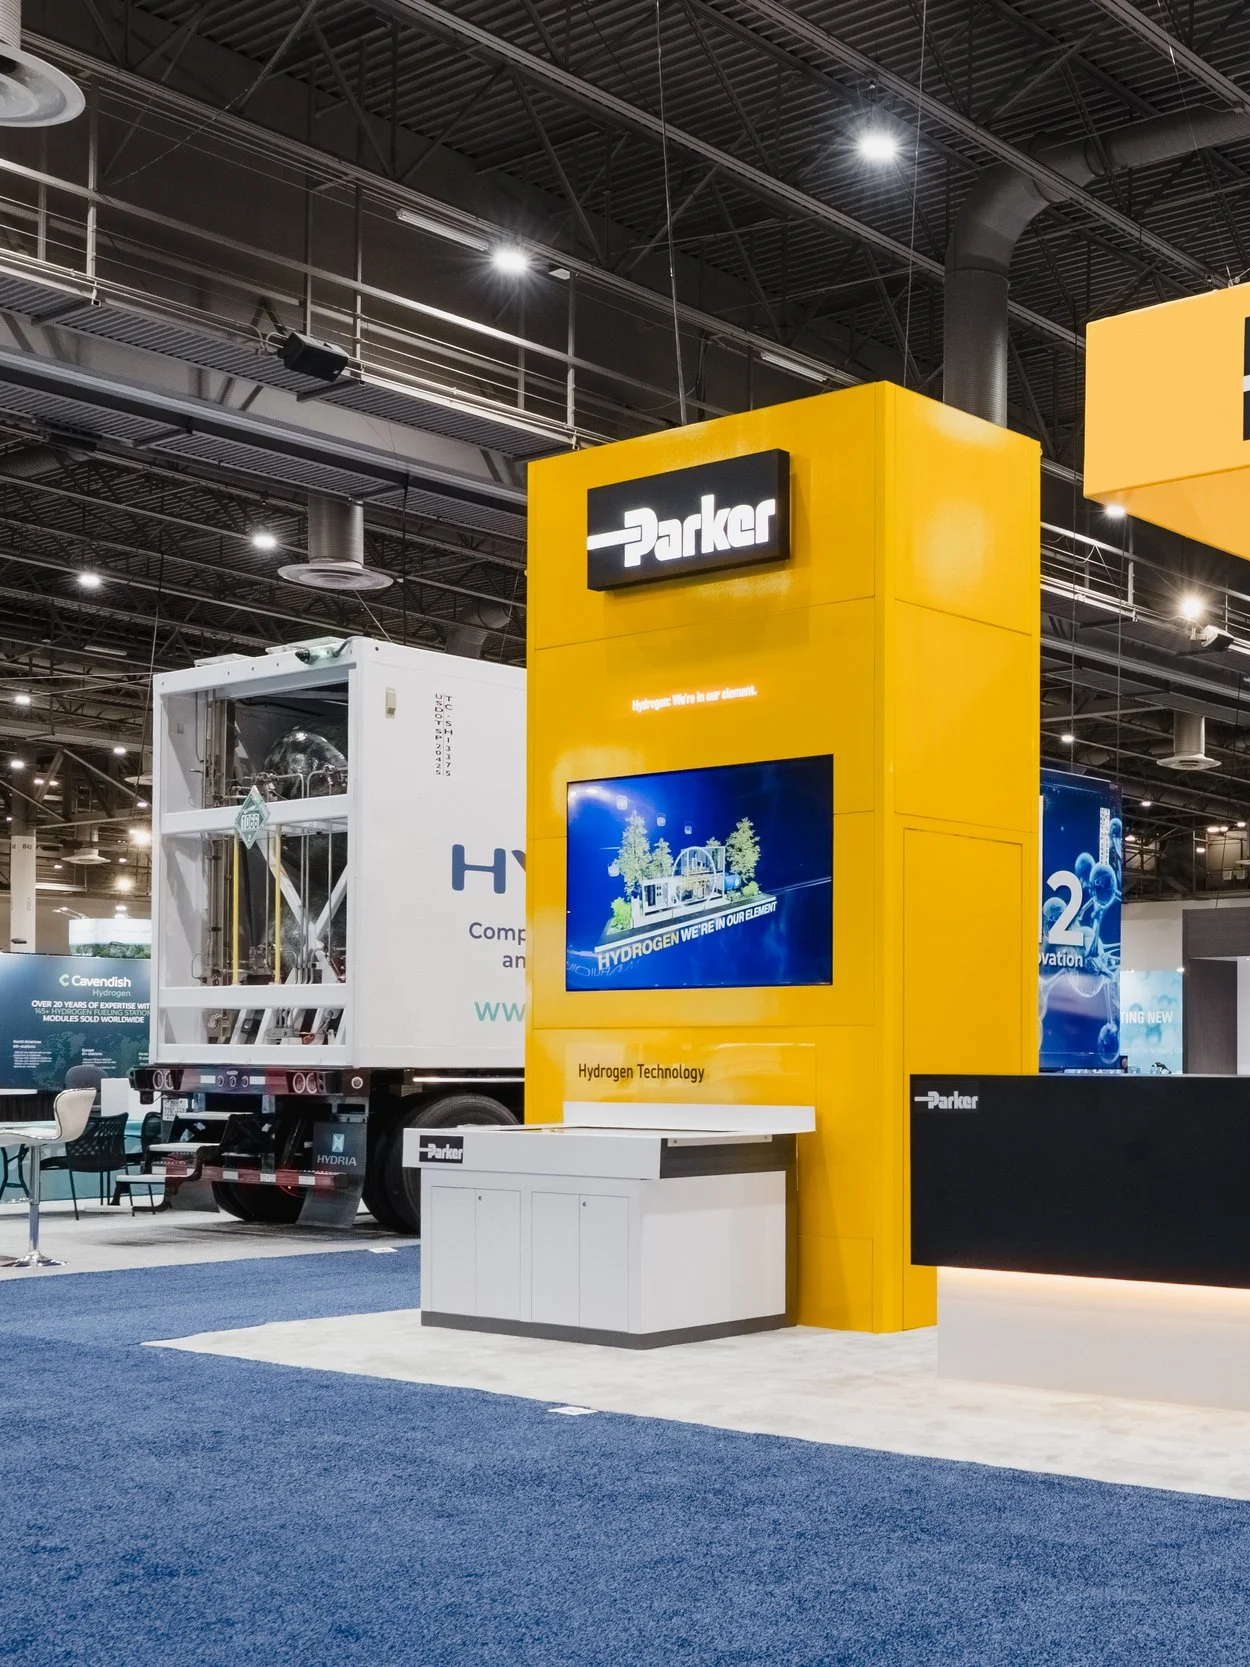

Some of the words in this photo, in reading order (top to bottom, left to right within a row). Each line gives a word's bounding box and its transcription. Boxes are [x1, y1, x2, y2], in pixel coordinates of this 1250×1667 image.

[624, 494, 776, 568] Parker
[434, 693, 444, 726] USDOT
[597, 932, 680, 971] HYDROGEN
[680, 922, 714, 942] WE'RE
[716, 918, 726, 931] IN
[726, 911, 745, 927] OUR
[745, 901, 778, 920] ELEMENT
[502, 955, 526, 968] an
[72, 975, 131, 987] Cavendish
[92, 989, 131, 998] Hydrogen
[31, 1000, 52, 1008] OVER
[64, 1001, 87, 1009] YEARS
[88, 1001, 99, 1009] OF
[100, 1002, 136, 1010] EXPERTISE
[51, 1008, 92, 1016] HYDROGEN
[1148, 1012, 1173, 1024] NEW
[43, 1015, 79, 1023] MODULES
[80, 1015, 99, 1023] SOLD
[100, 1016, 145, 1024] WORLDWIDE
[578, 1063, 634, 1081] Hydrogen
[637, 1063, 705, 1083] Technology
[927, 1091, 978, 1109] Parker
[428, 1143, 463, 1159] Parker
[317, 1154, 357, 1167] HYDRIA
